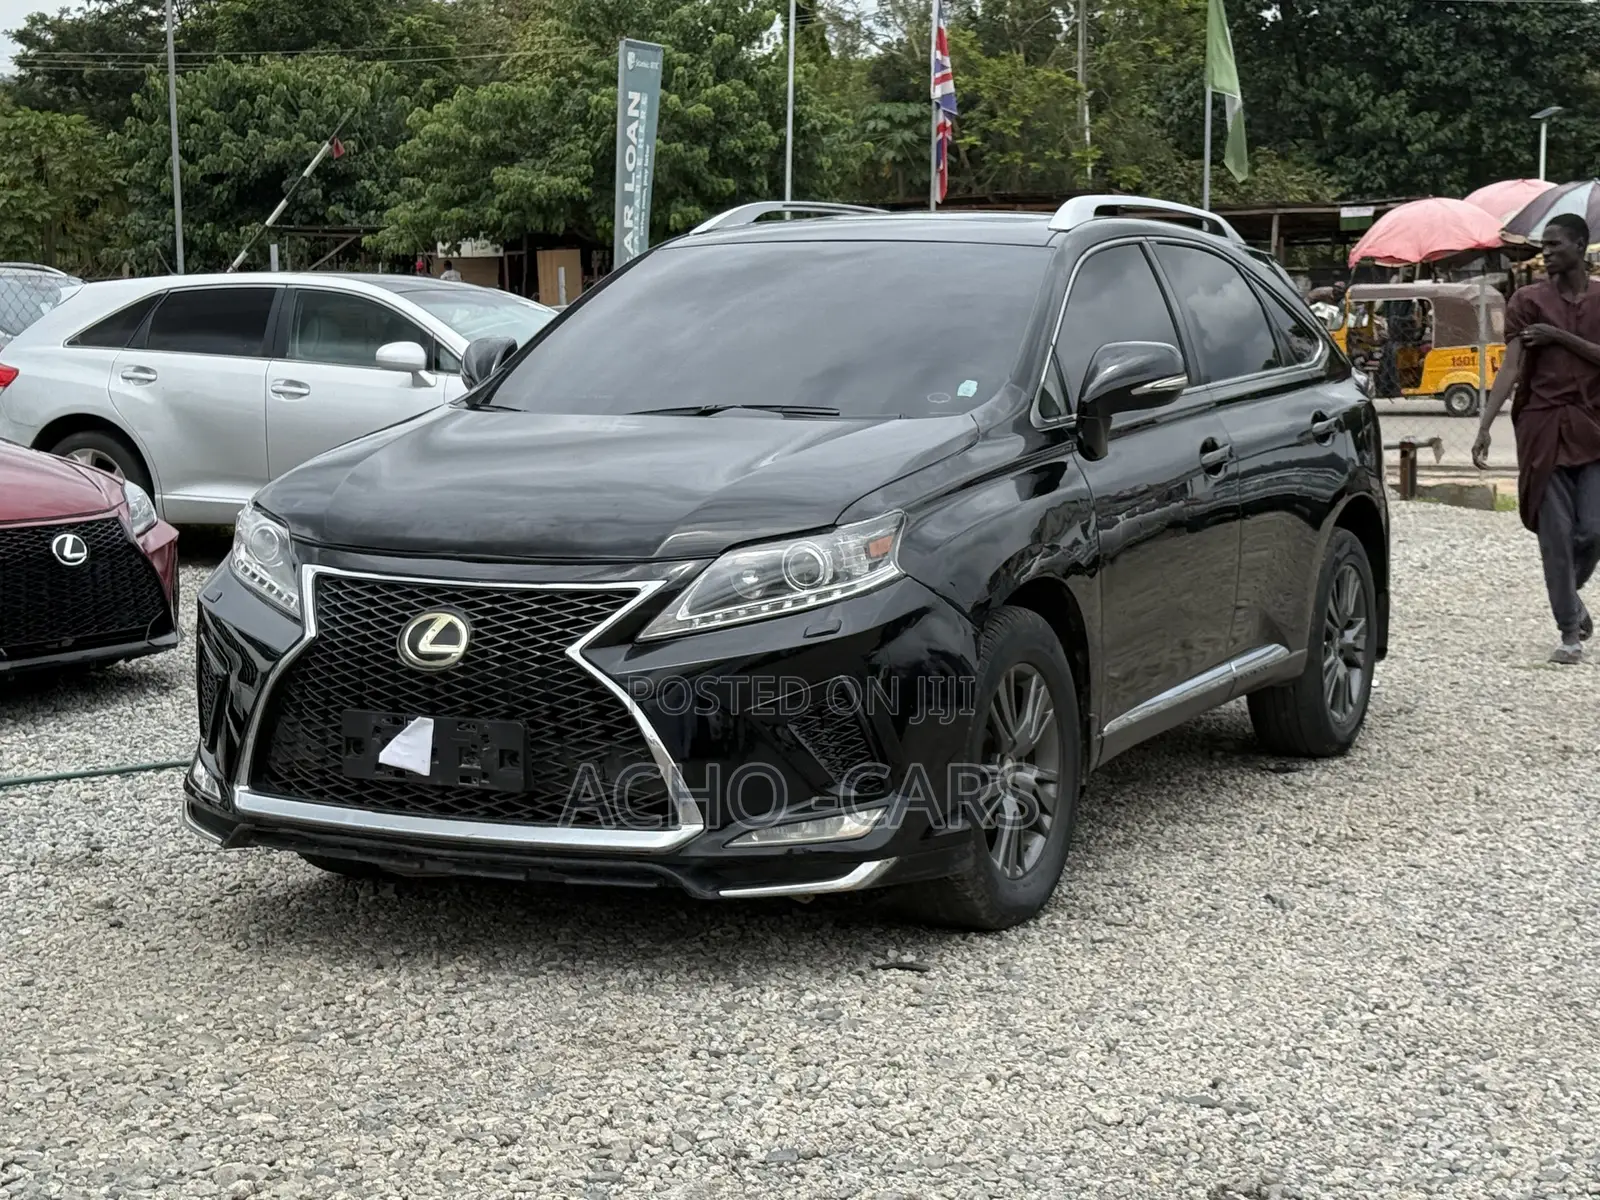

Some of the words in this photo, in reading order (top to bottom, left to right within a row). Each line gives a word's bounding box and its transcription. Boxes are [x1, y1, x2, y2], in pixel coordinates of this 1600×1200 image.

[625, 91, 640, 192] LOAN
[637, 92, 648, 149] HERE
[633, 157, 643, 257] VAILABLE
